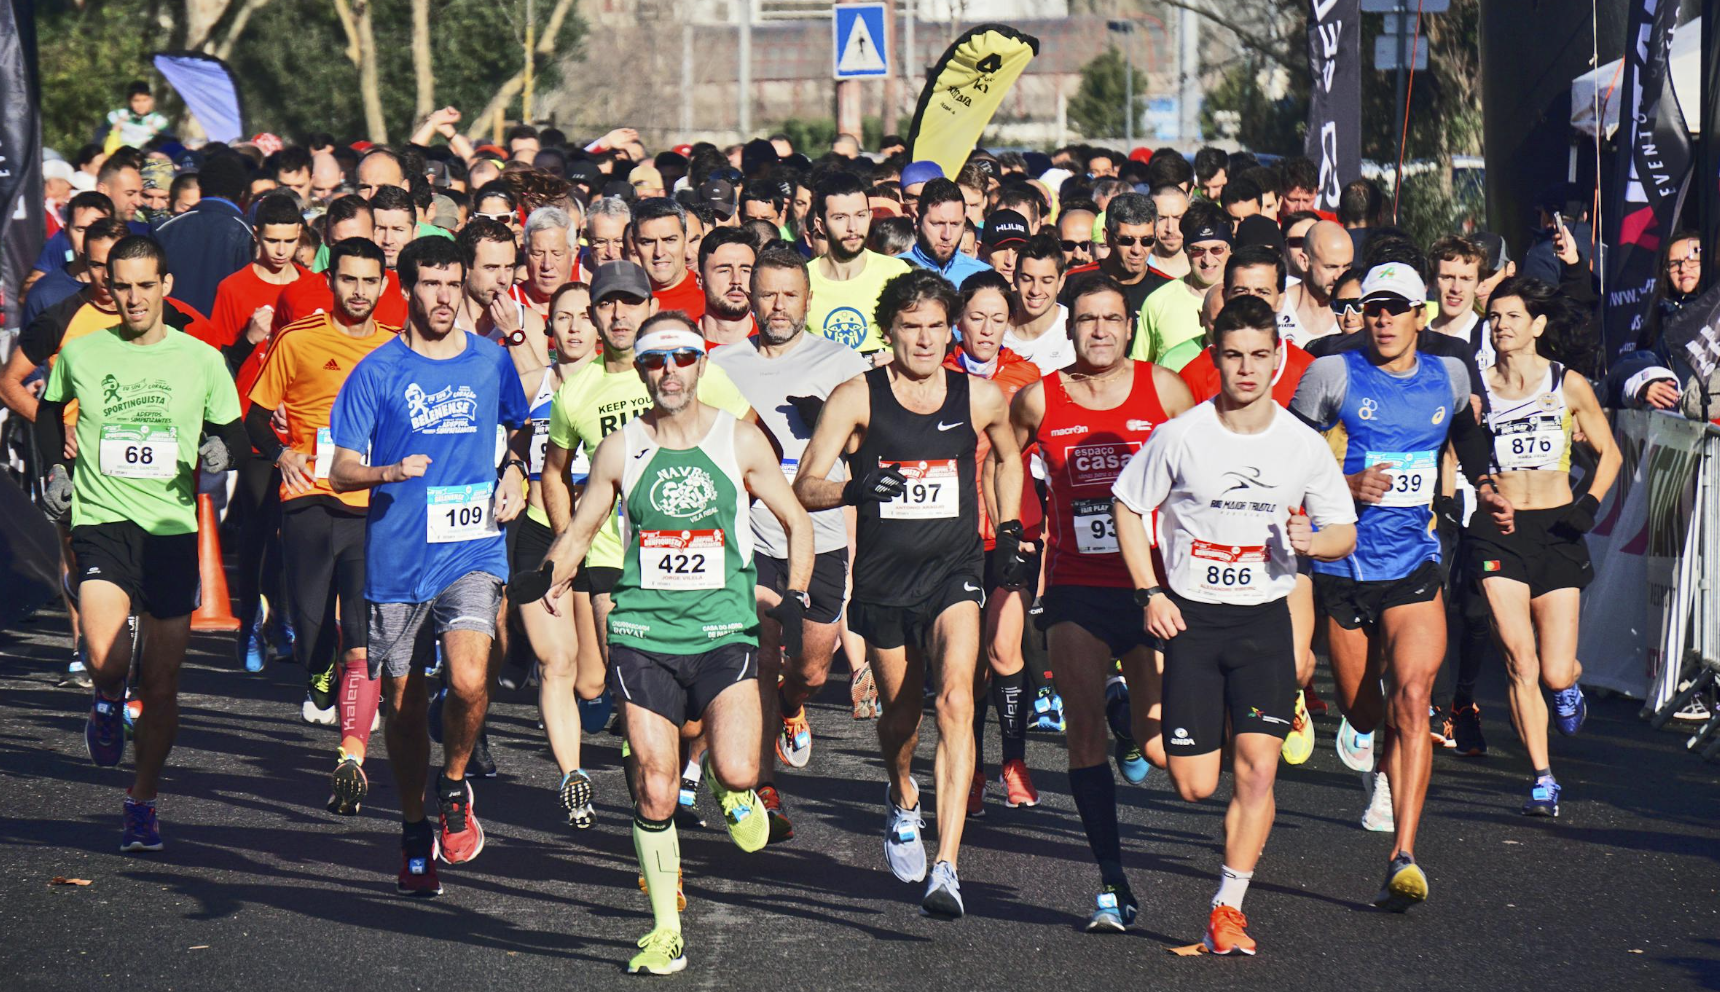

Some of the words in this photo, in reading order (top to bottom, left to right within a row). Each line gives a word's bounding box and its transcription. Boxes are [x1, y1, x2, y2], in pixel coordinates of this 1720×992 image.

[103, 396, 166, 417] SPORTINGUISTA
[411, 402, 470, 429] BELENENSE
[598, 401, 627, 414] KEEP
[1051, 425, 1089, 436] macron
[125, 445, 153, 464] 68
[1074, 447, 1115, 458] espaço
[1512, 436, 1551, 454] 876
[1076, 453, 1133, 471] casa
[1390, 474, 1422, 493] 39
[903, 484, 942, 504] 197
[446, 506, 482, 527] 109
[1081, 506, 1093, 514] FAIR
[1094, 504, 1109, 512] PLAY
[658, 553, 706, 574] 422
[1207, 566, 1251, 586] 866
